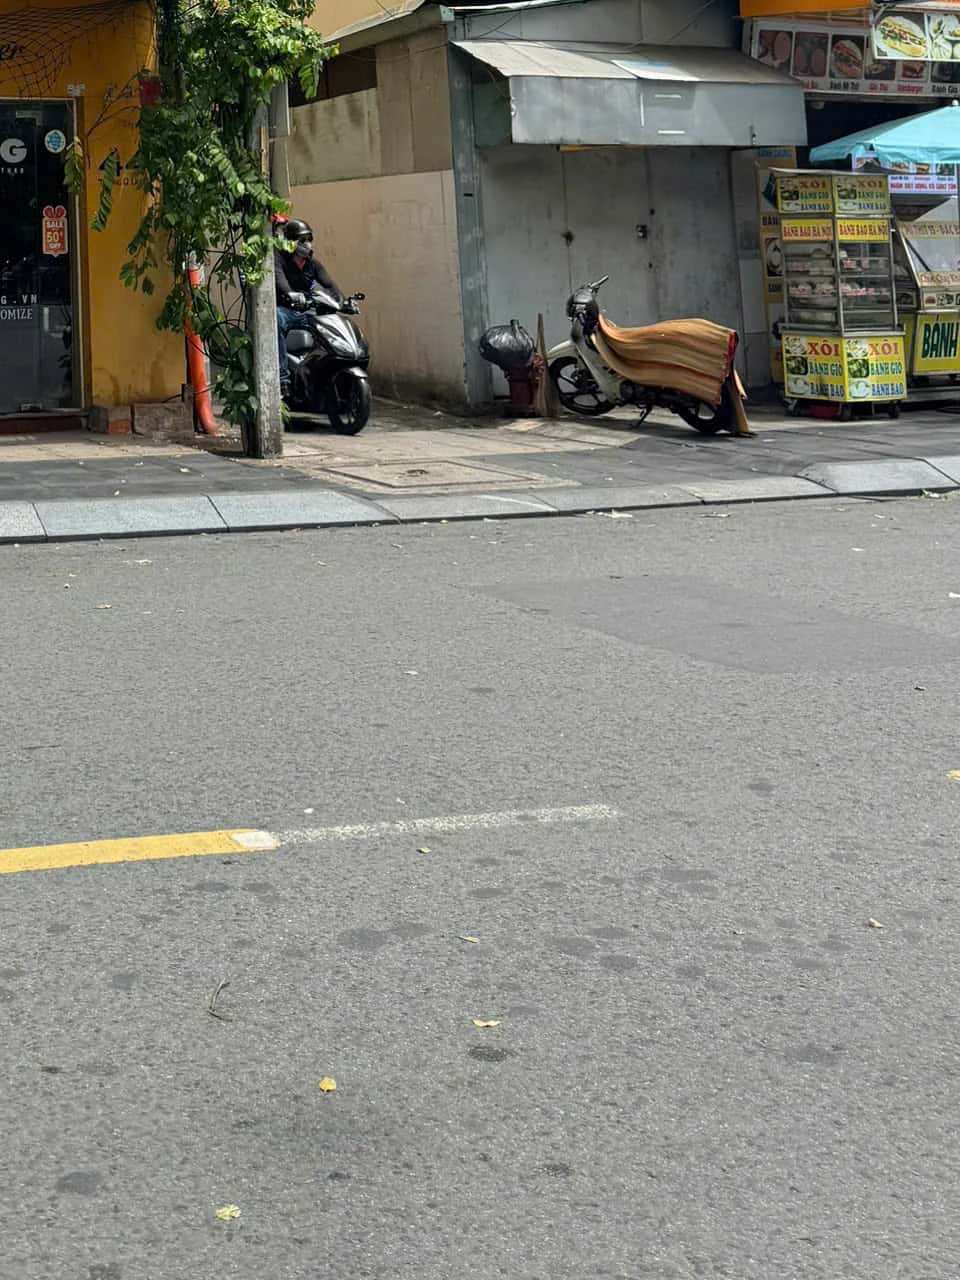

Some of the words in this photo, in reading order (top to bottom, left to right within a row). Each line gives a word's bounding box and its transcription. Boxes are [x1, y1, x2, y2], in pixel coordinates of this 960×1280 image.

[47, 220, 64, 228] SALE
[808, 340, 840, 356] XÔI
[869, 339, 899, 355] XÔI
